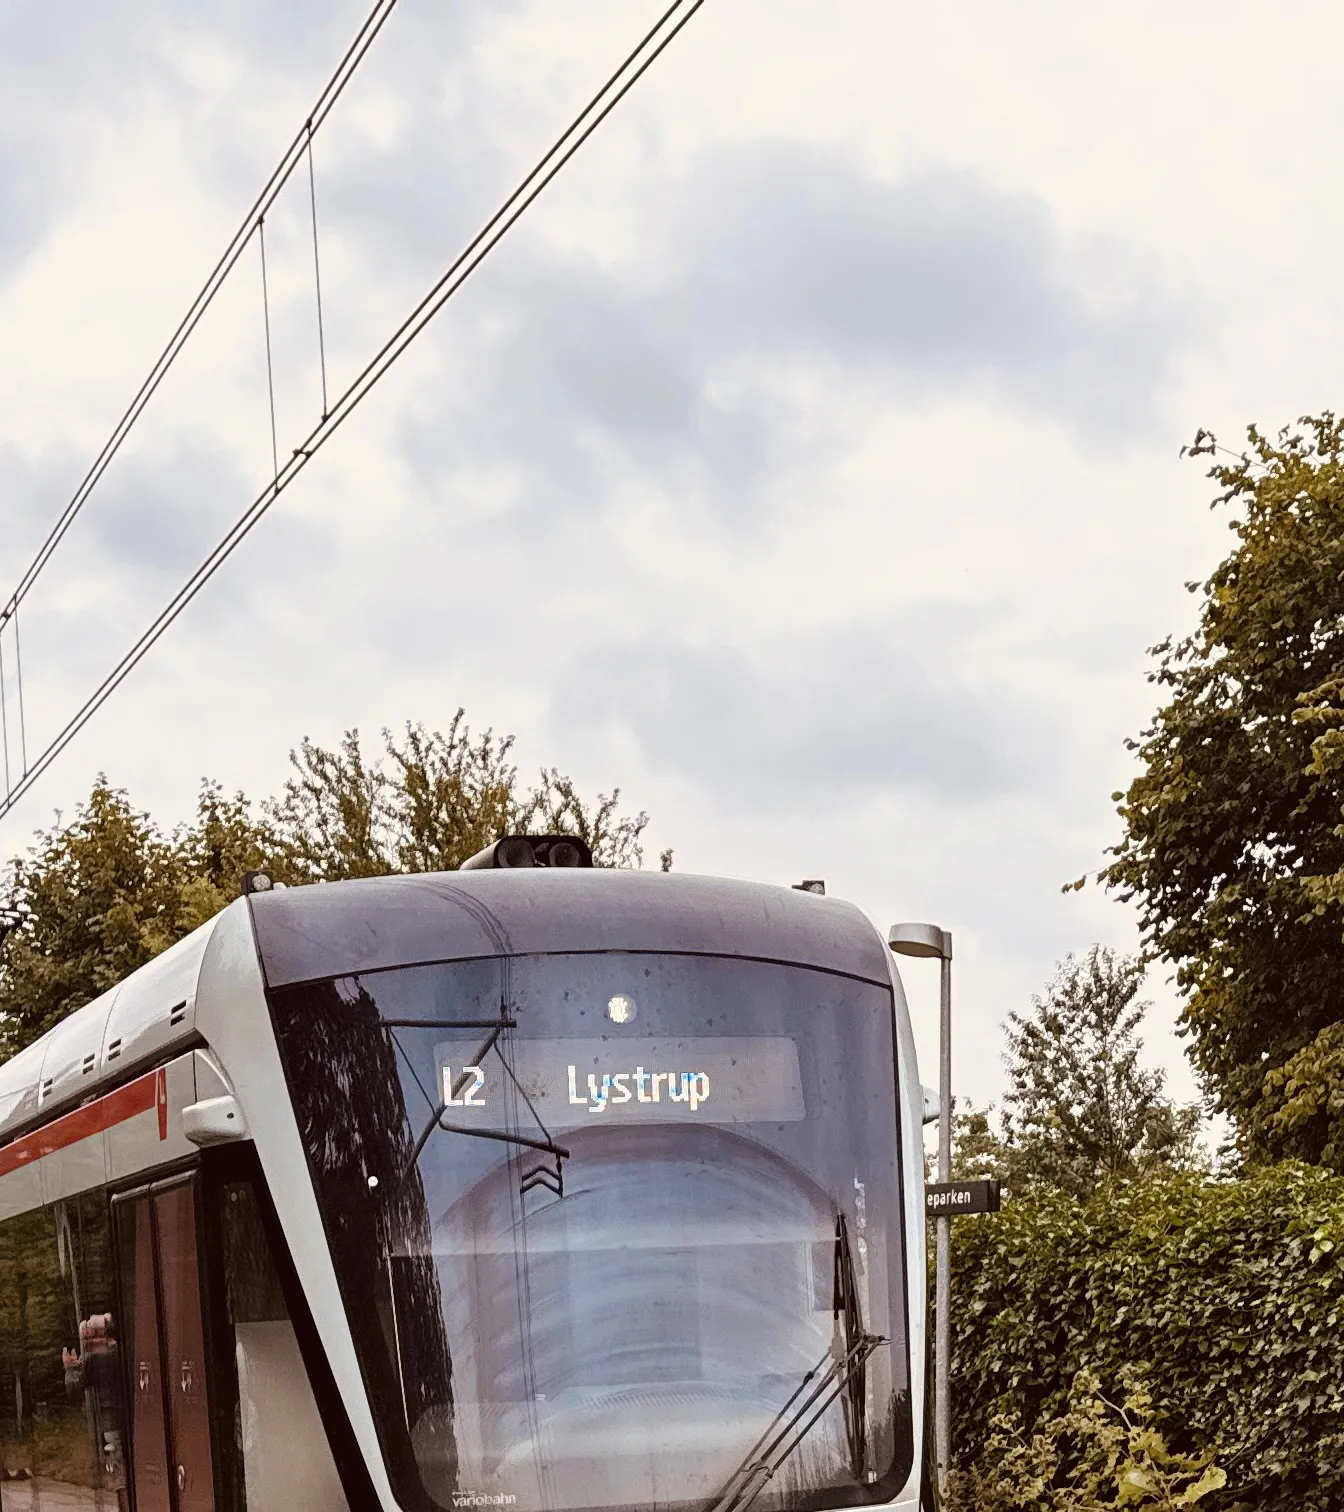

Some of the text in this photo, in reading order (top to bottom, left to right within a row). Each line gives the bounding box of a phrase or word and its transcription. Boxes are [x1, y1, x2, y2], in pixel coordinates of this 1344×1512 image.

[441, 1065, 710, 1112] L2 Lystrup
[927, 1188, 971, 1209] eparken
[452, 1492, 516, 1507] variobahn
